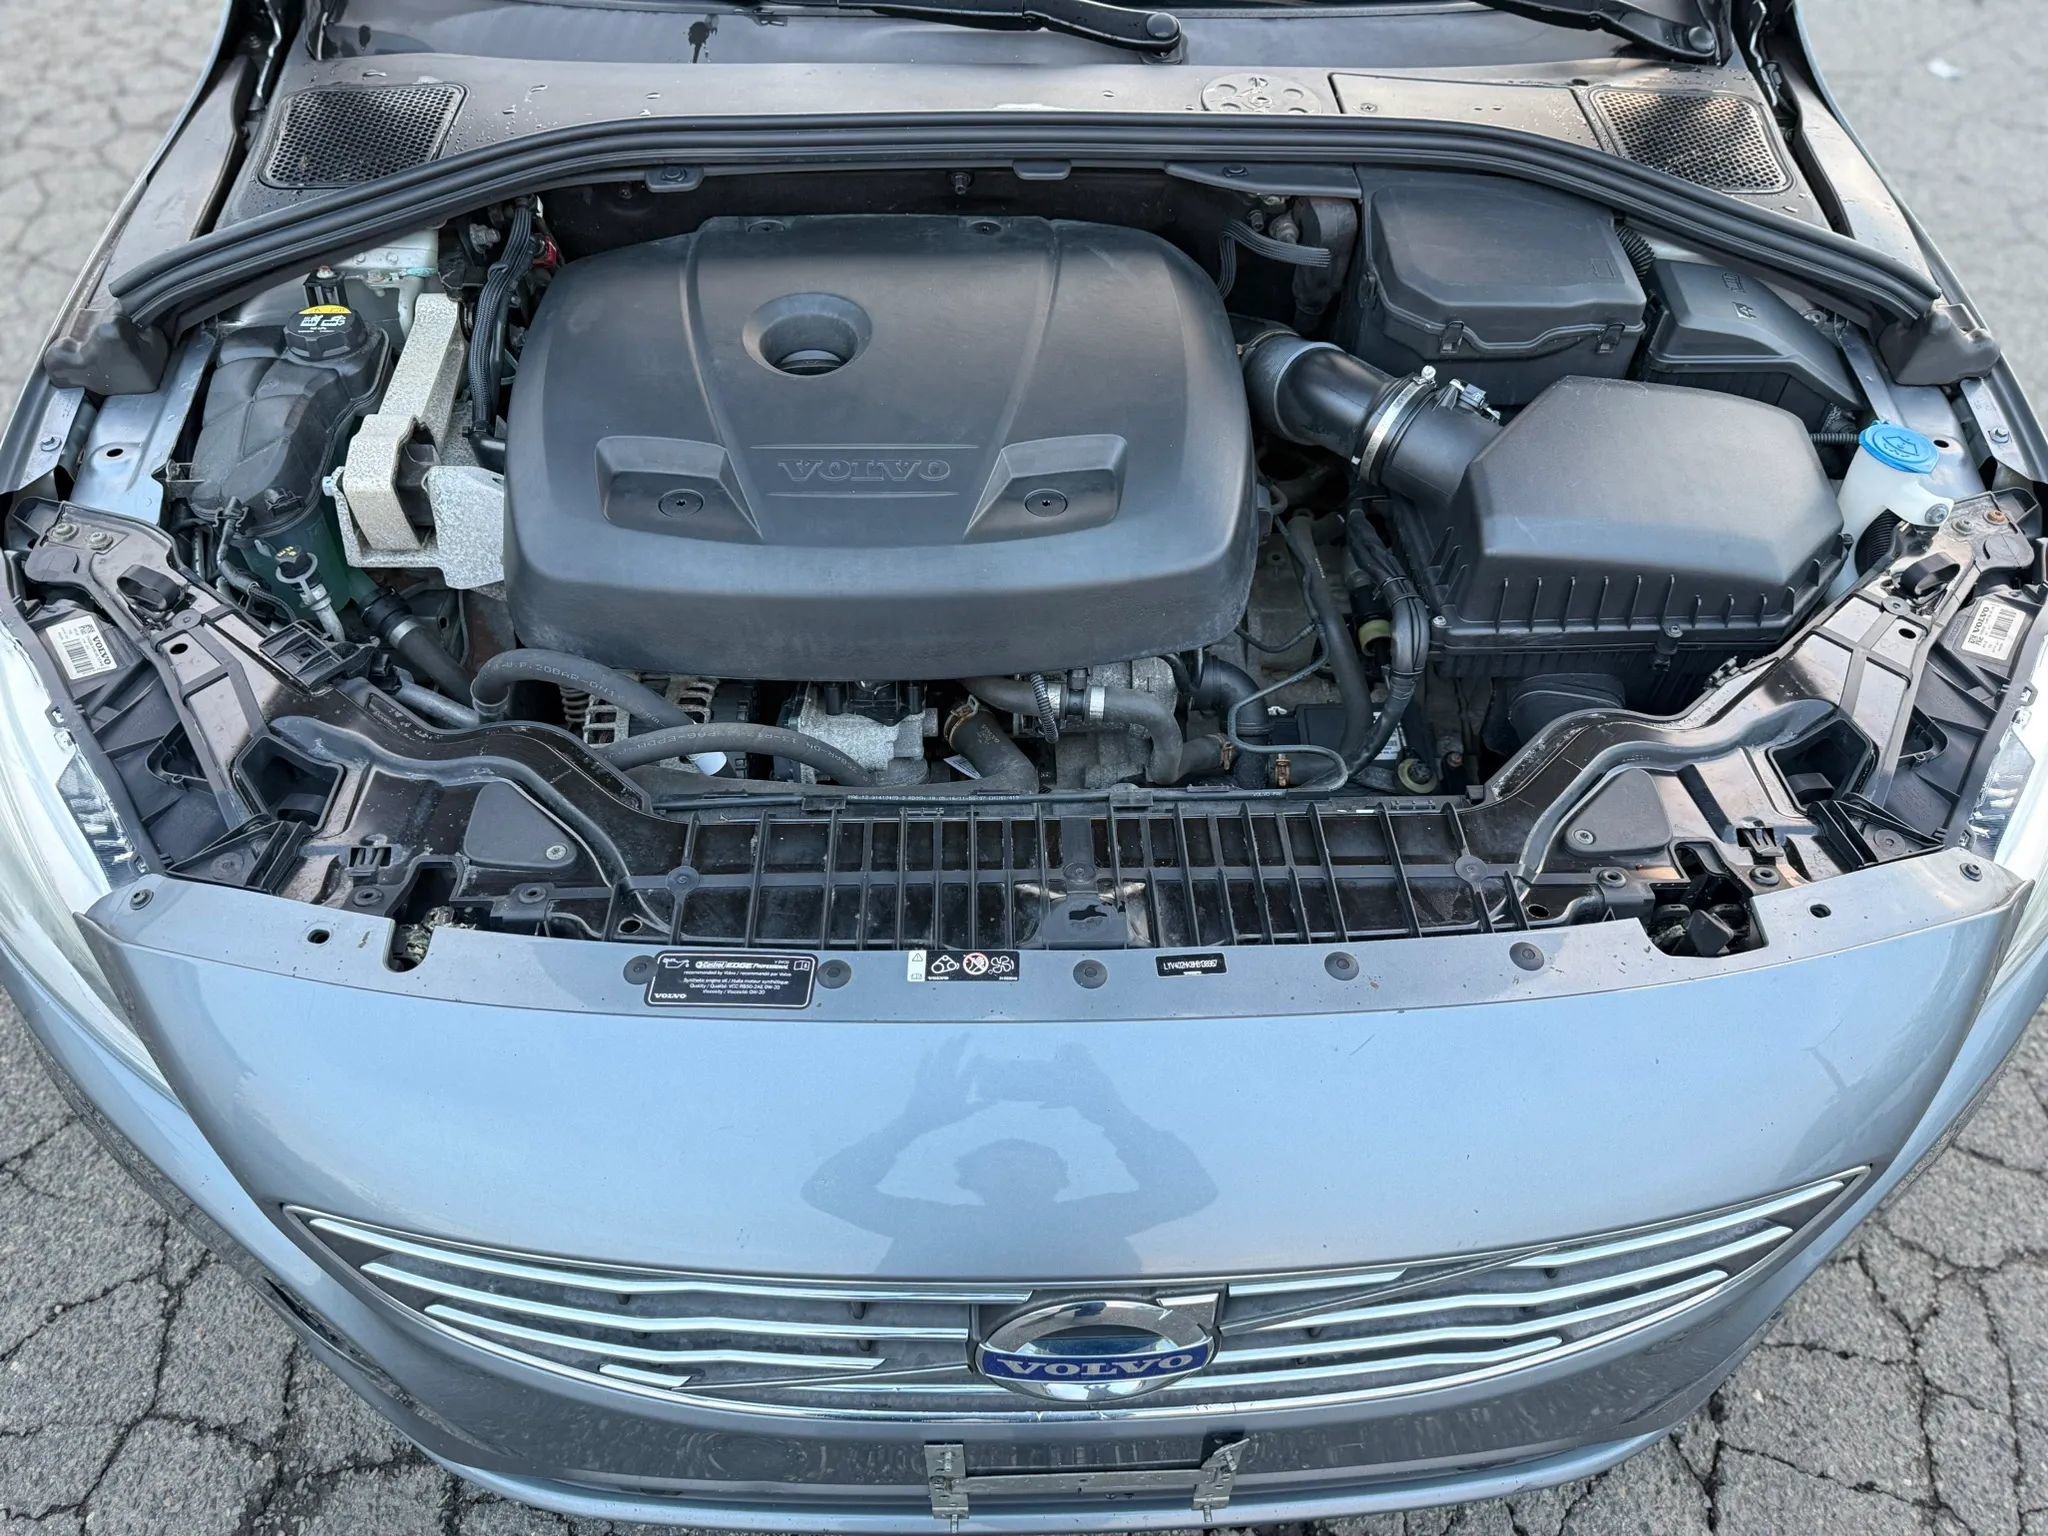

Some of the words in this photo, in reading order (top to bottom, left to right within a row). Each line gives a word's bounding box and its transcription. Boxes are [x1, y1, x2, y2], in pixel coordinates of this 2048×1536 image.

[777, 459, 950, 481] VOLVO
[1972, 606, 1990, 633] VOLVO
[93, 635, 111, 665] VOLVO
[997, 1354, 1194, 1376] VOLVO
